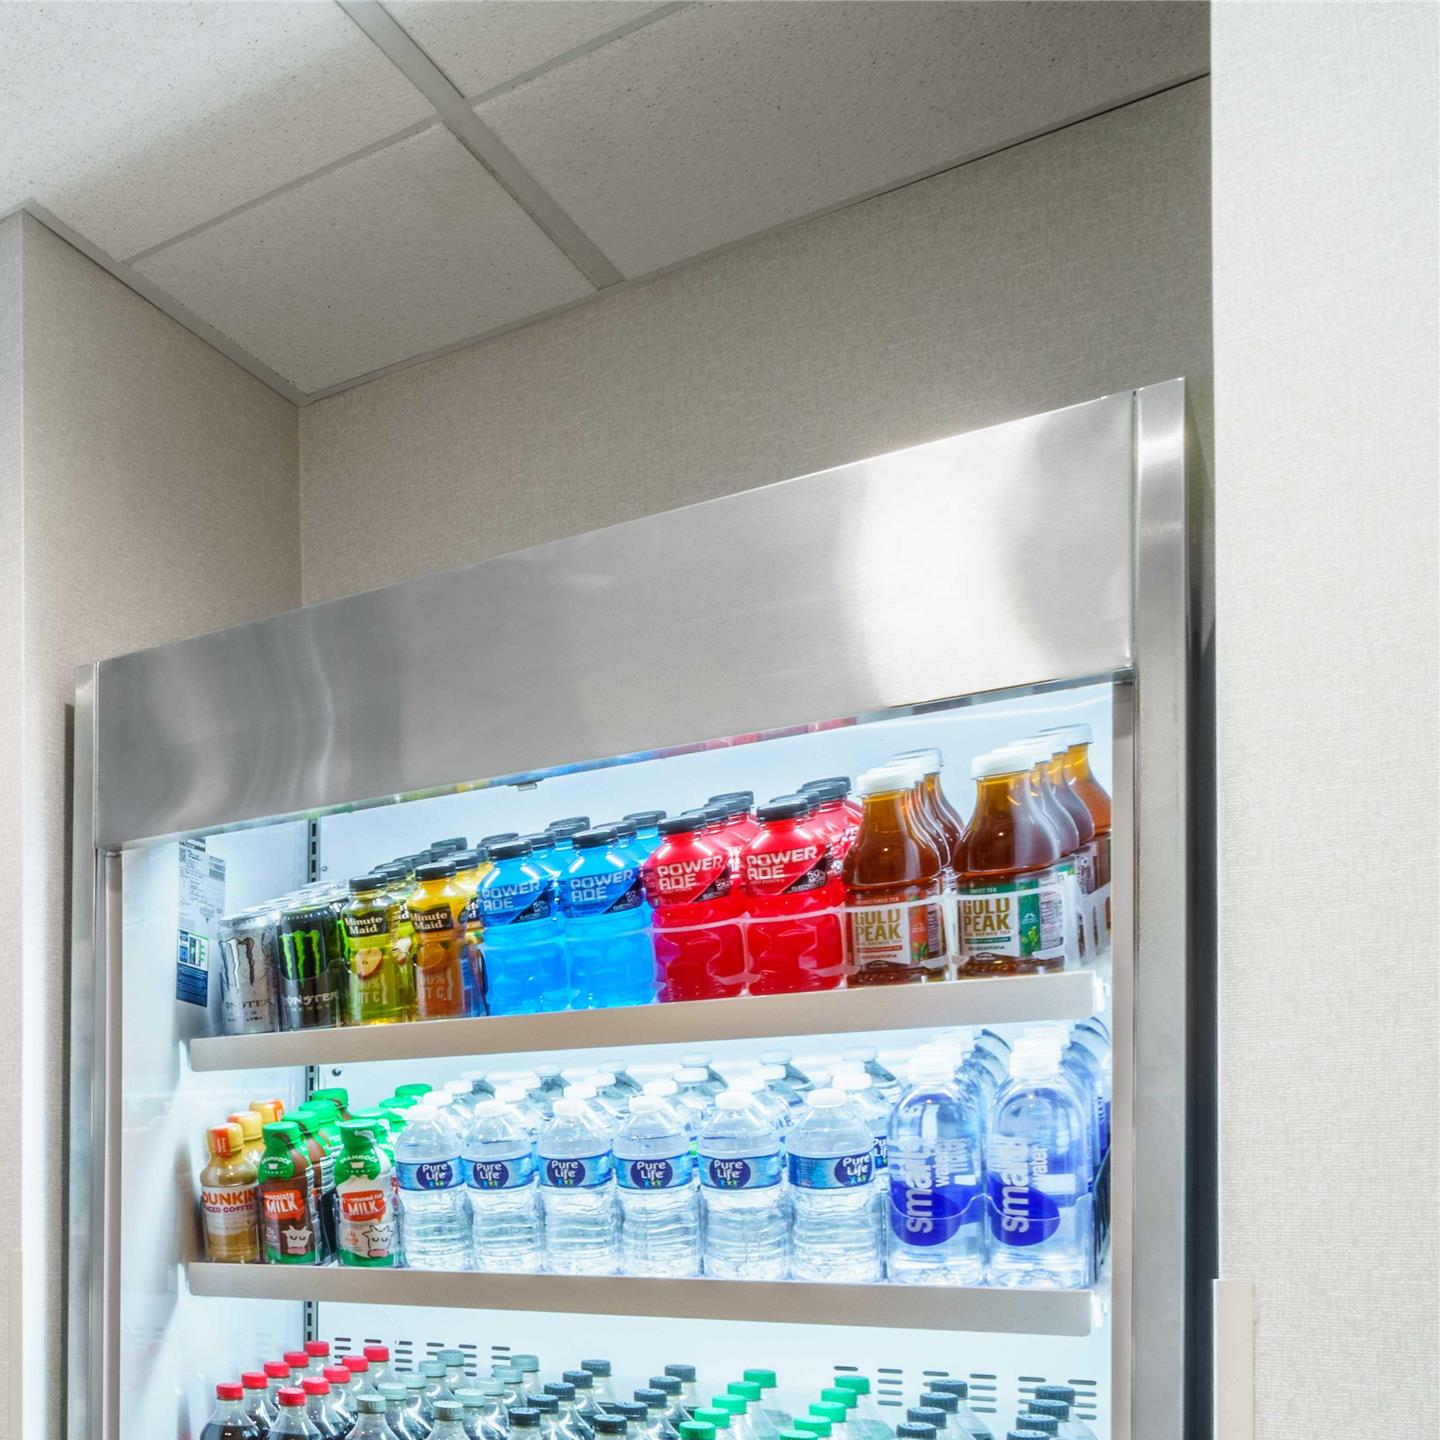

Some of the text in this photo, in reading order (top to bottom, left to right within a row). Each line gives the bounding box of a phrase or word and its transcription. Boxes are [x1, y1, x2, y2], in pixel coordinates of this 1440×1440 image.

[746, 846, 818, 865] POWER
[657, 855, 723, 877] POWER
[747, 864, 785, 881] ADE
[570, 869, 635, 889] POWER
[658, 873, 697, 891] ADE
[481, 880, 541, 899] POWER
[571, 886, 608, 901] ADE
[484, 898, 514, 911] ADE
[963, 897, 1010, 915] GOLD
[344, 916, 383, 925] Minute
[409, 911, 448, 921] Minute
[414, 920, 443, 930] Maid
[964, 914, 1011, 932] PEAK
[349, 925, 379, 935] Maid
[856, 924, 902, 941] PEAK
[552, 1160, 579, 1170] Pure
[637, 1160, 666, 1170] Pure
[713, 1160, 743, 1170] Pure
[843, 1154, 870, 1167] Pure
[422, 1162, 448, 1173] Pure
[476, 1162, 502, 1173] Pure
[846, 1164, 869, 1176] Life
[426, 1170, 447, 1181] Life
[480, 1170, 501, 1181] Life
[554, 1168, 577, 1180] Life
[640, 1169, 665, 1180] Life
[717, 1169, 741, 1181] Life
[223, 1203, 254, 1213] COFFEE
[266, 1198, 298, 1214] MILK
[347, 1200, 378, 1216] MILK
